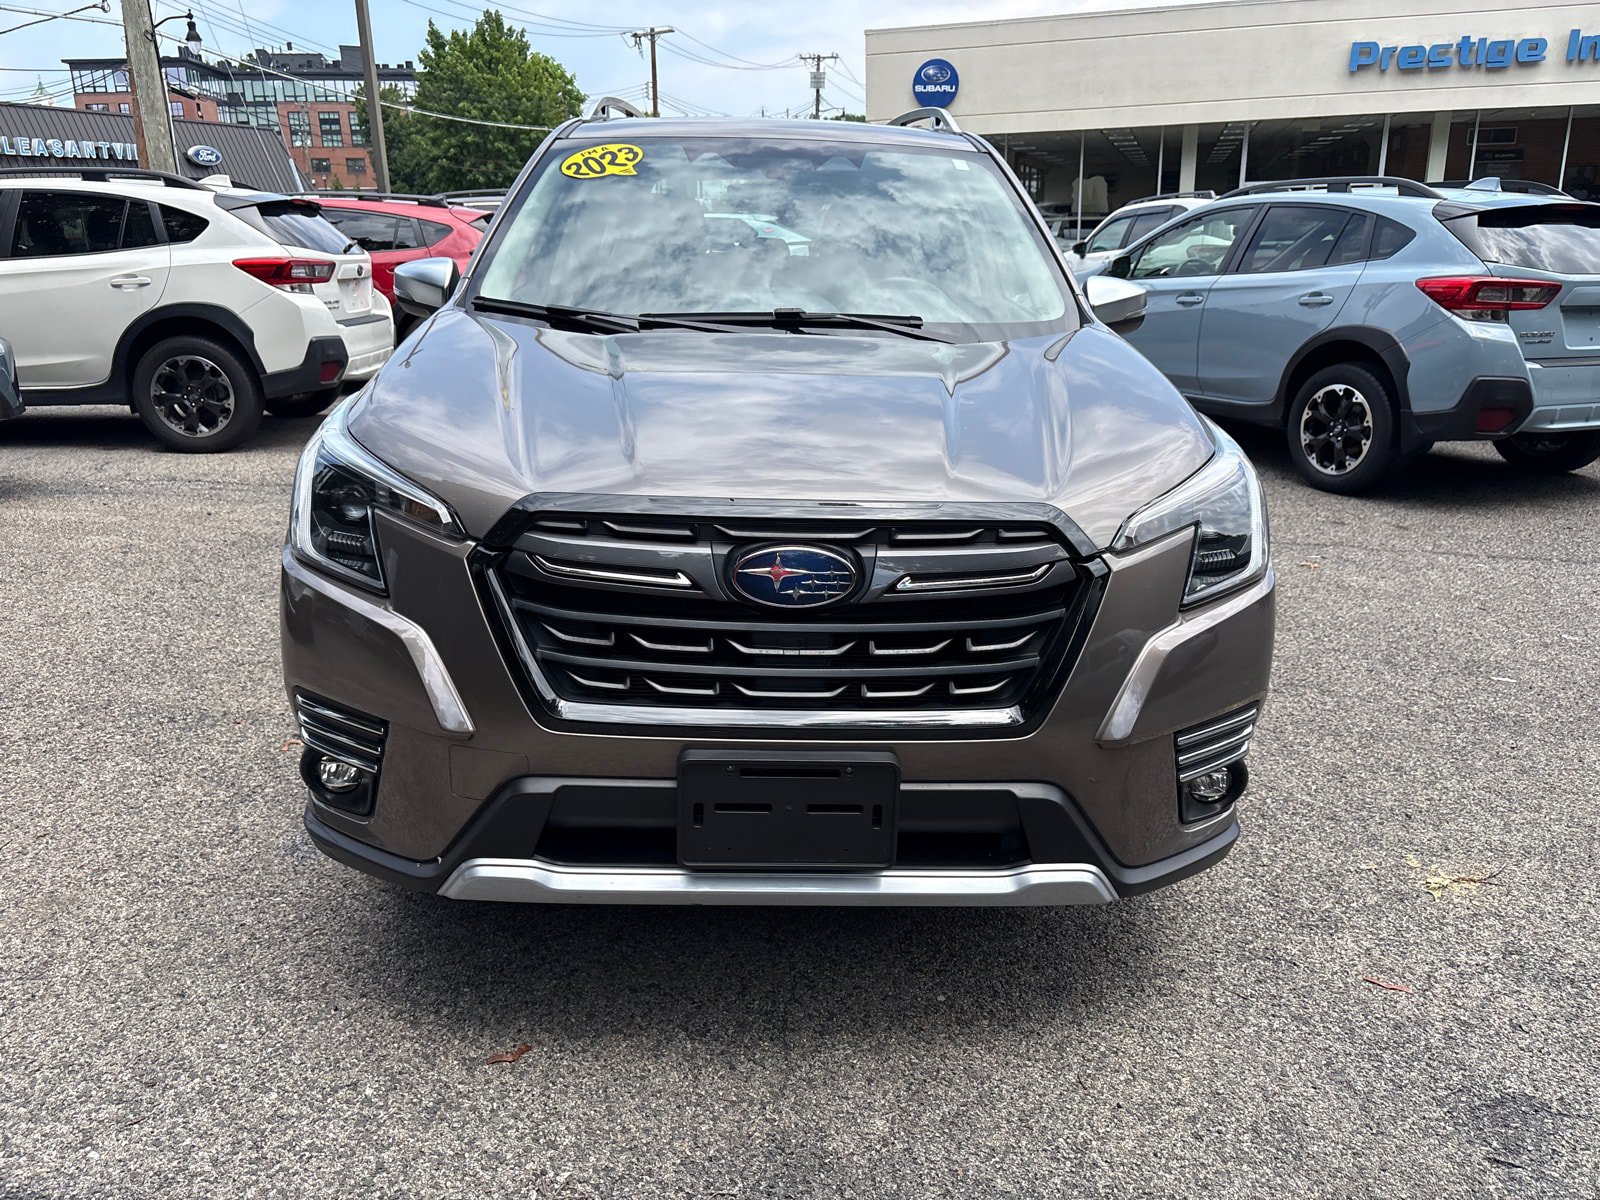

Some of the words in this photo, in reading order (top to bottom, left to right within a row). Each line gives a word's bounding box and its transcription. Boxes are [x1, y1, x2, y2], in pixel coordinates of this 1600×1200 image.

[1350, 35, 1548, 72] Prestige
[914, 84, 956, 93] SUBARU
[198, 149, 217, 162] Ford
[580, 150, 598, 158] I'M
[565, 146, 639, 176] 2023
